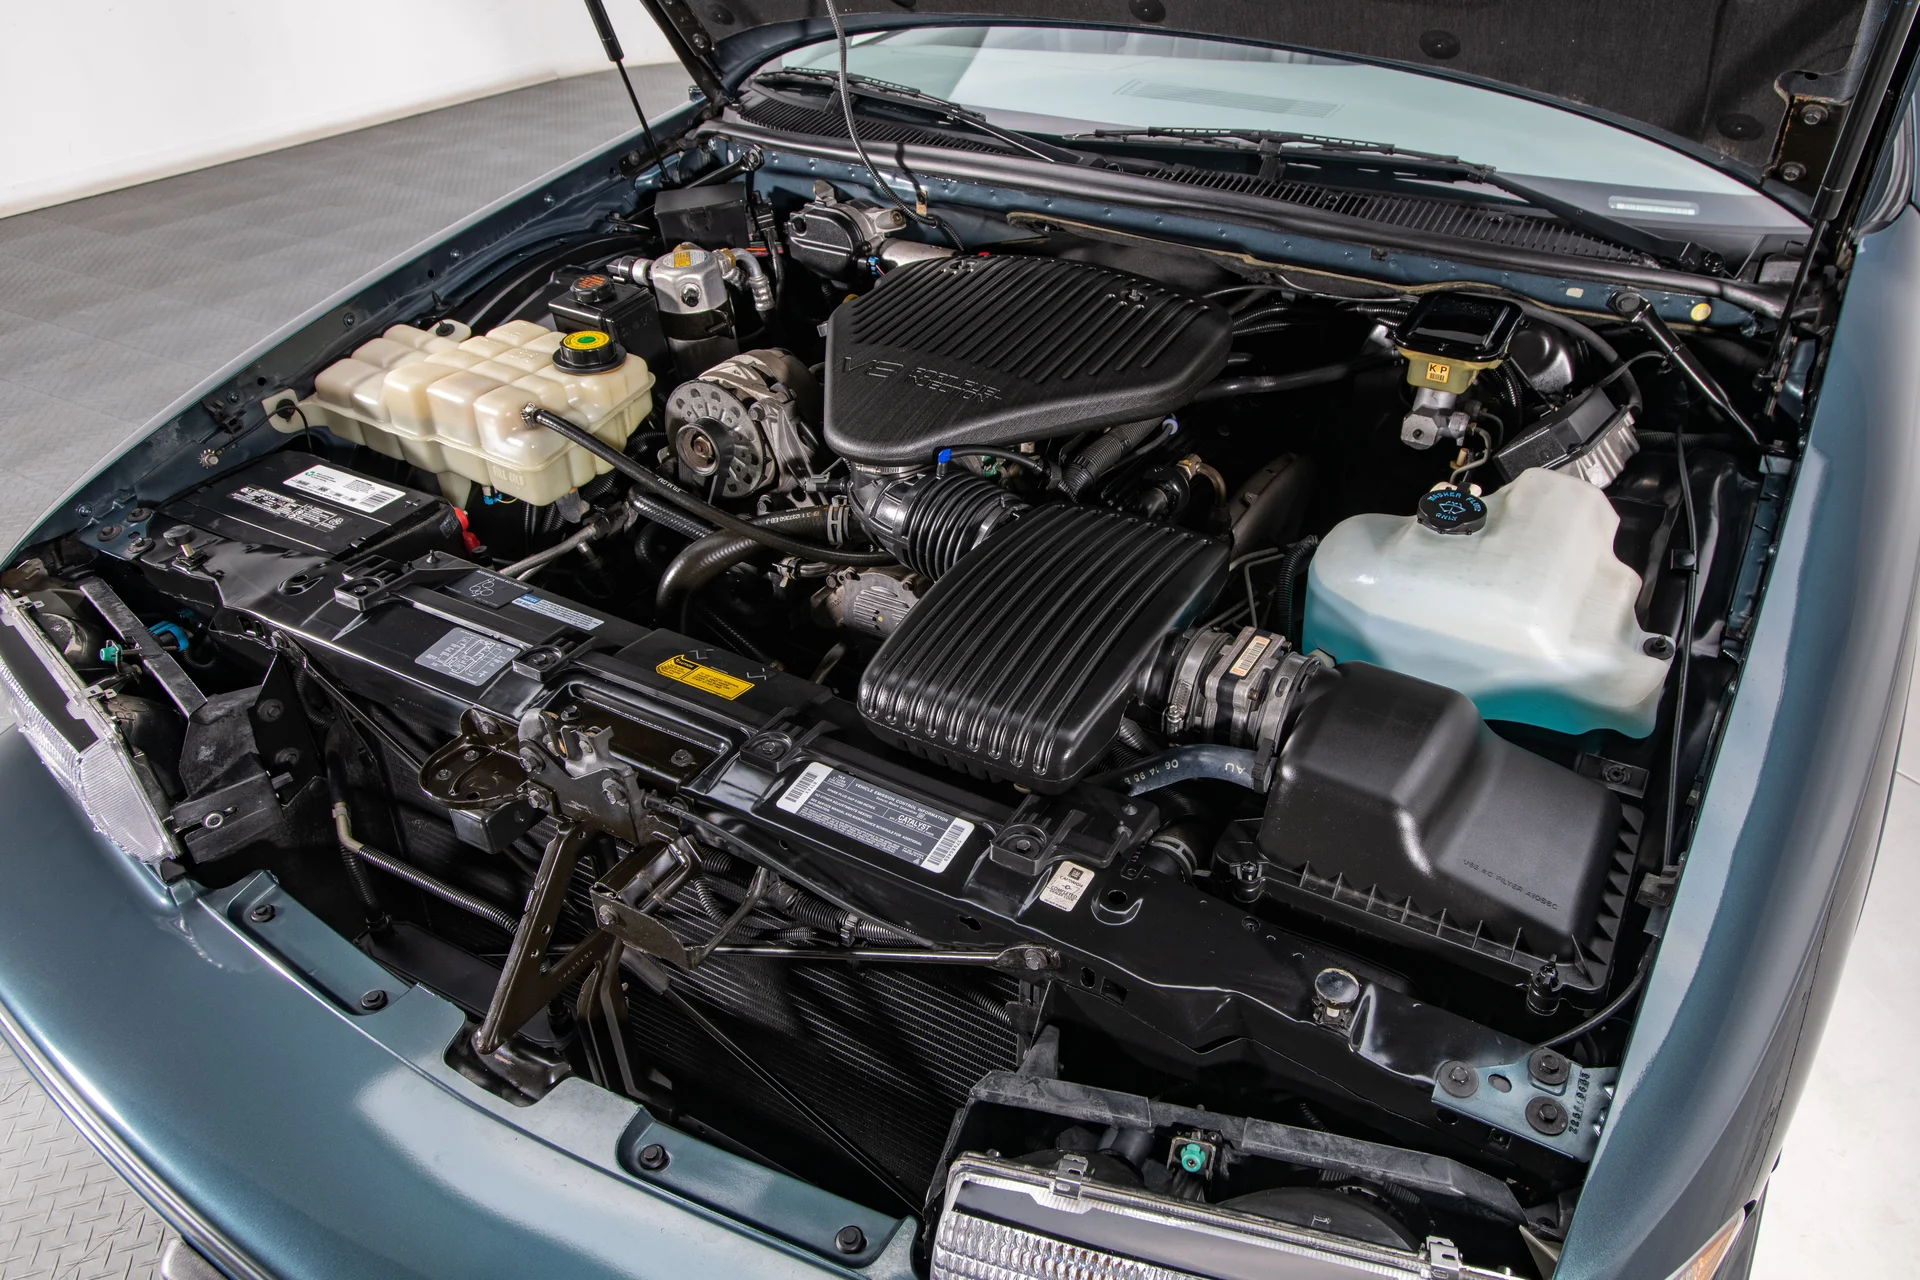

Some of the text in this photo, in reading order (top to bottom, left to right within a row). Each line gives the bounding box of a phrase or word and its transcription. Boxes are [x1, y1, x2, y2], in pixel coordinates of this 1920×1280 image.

[904, 374, 990, 402] INJECTION
[911, 366, 1002, 400] PORT FUEL
[1427, 492, 1482, 512] WASHER FLUID
[1435, 513, 1458, 521] ONLY
[1164, 759, 1179, 770] 06
[816, 800, 832, 808] SERVICE
[831, 800, 858, 812] ADJUSTMENTS
[854, 782, 949, 822] VEHICLE EMISSION CONTROL INFORMATION
[896, 814, 931, 831] CATALYST
[1051, 886, 1077, 899] COMPLETED
[1495, 875, 1523, 893] FILTER
